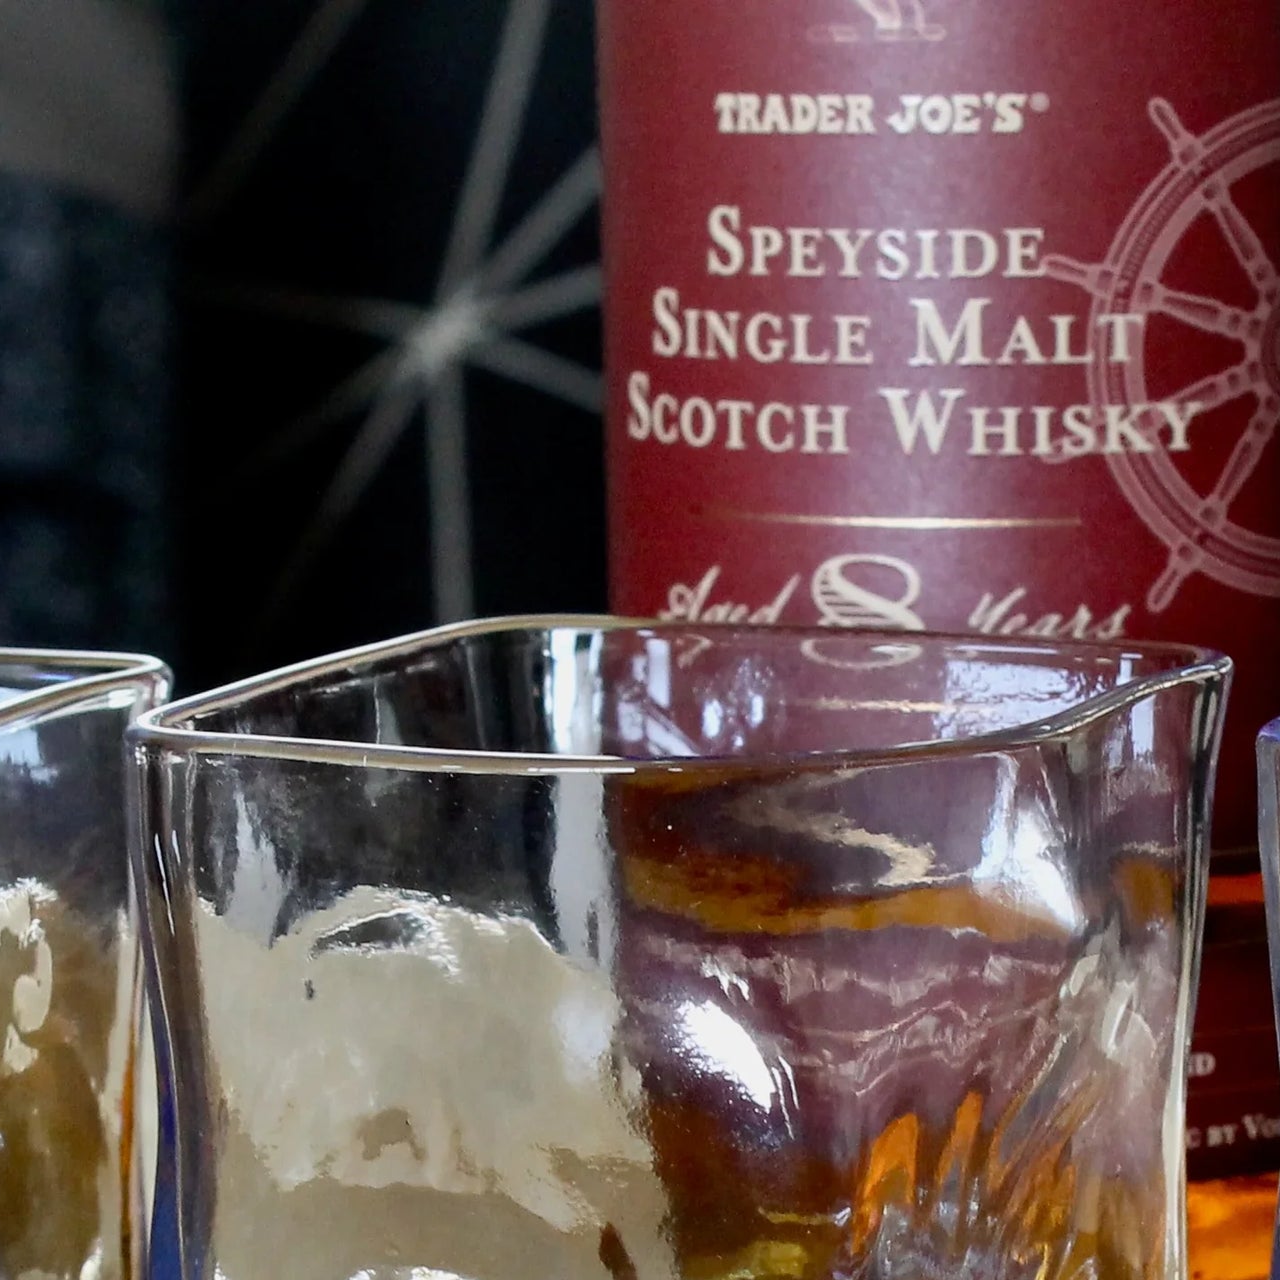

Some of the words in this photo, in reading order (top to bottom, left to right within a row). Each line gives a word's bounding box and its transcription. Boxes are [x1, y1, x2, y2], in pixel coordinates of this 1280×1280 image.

[715, 92, 877, 135] TRADER
[707, 205, 1045, 281] SPEYSIDE
[652, 287, 873, 364] SINGLE
[908, 298, 1144, 366] MALT
[628, 371, 850, 454] SCOTCH
[880, 387, 1204, 456] WHISKY
[658, 565, 801, 626] Aged
[806, 553, 926, 667] 8
[968, 587, 1132, 640] Years
